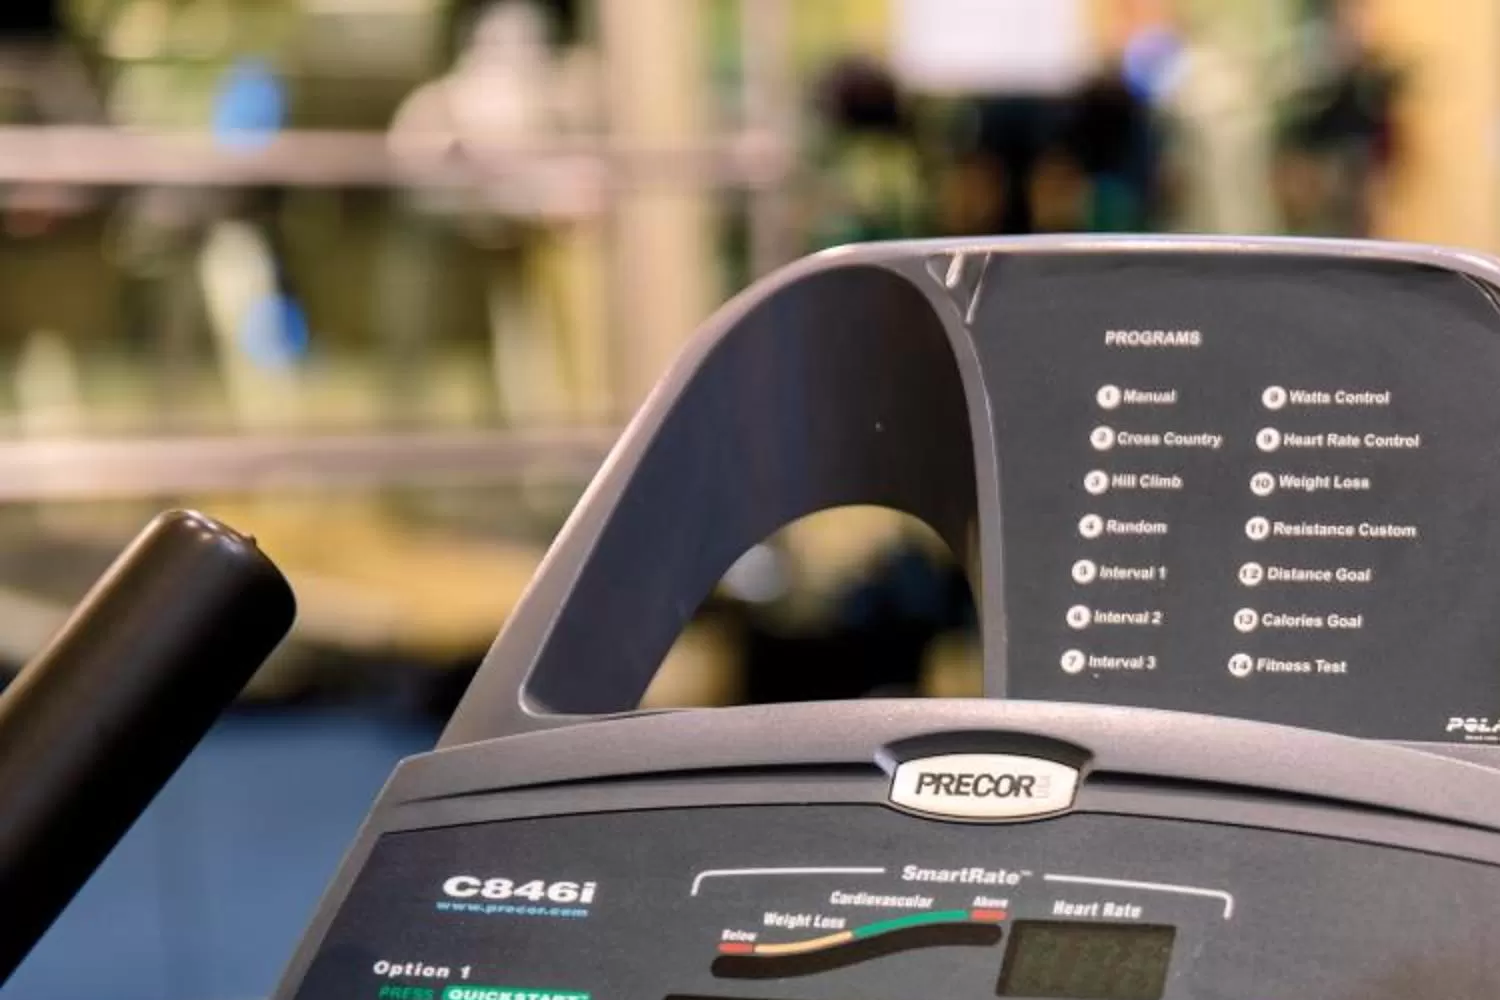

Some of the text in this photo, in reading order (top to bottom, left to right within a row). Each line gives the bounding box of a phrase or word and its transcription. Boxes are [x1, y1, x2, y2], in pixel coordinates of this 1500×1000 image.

[1105, 330, 1202, 346] PROGRAMS
[1123, 389, 1178, 403] Manual
[1289, 389, 1331, 404] Watts
[1334, 390, 1391, 404] Control
[1117, 431, 1160, 446] Cross
[1163, 431, 1223, 449] Country
[1283, 432, 1324, 446] Heart
[1327, 433, 1361, 447] Rate
[1363, 433, 1420, 448] Control
[1111, 474, 1137, 488] Hill
[1139, 474, 1184, 489] Climb
[1279, 474, 1330, 492] Weight
[1333, 475, 1370, 490] Loss
[1106, 519, 1168, 535] Random
[1273, 521, 1354, 537] Resistance
[1358, 522, 1417, 537] Custom
[1099, 565, 1154, 580] Interval
[1158, 566, 1167, 580] 1
[1267, 566, 1332, 582] Distance
[1335, 567, 1372, 582] Goal
[1094, 610, 1149, 625] Interval
[1151, 611, 1163, 625] 2
[1262, 613, 1324, 628] Calories
[1327, 613, 1363, 629] Goal
[1089, 655, 1143, 670] Interval
[1146, 655, 1157, 670] 3
[1256, 657, 1311, 673] Fitness
[1315, 659, 1348, 674] Test
[915, 772, 1036, 797] PRECOR
[442, 875, 597, 904] C846i
[829, 890, 935, 909] Cardiovascular
[435, 901, 589, 917] www.precor.com
[1052, 899, 1142, 919] Heart Rate
[763, 911, 847, 931] Weight Loss
[373, 960, 472, 980] Option 1
[378, 986, 435, 1000] PRESS
